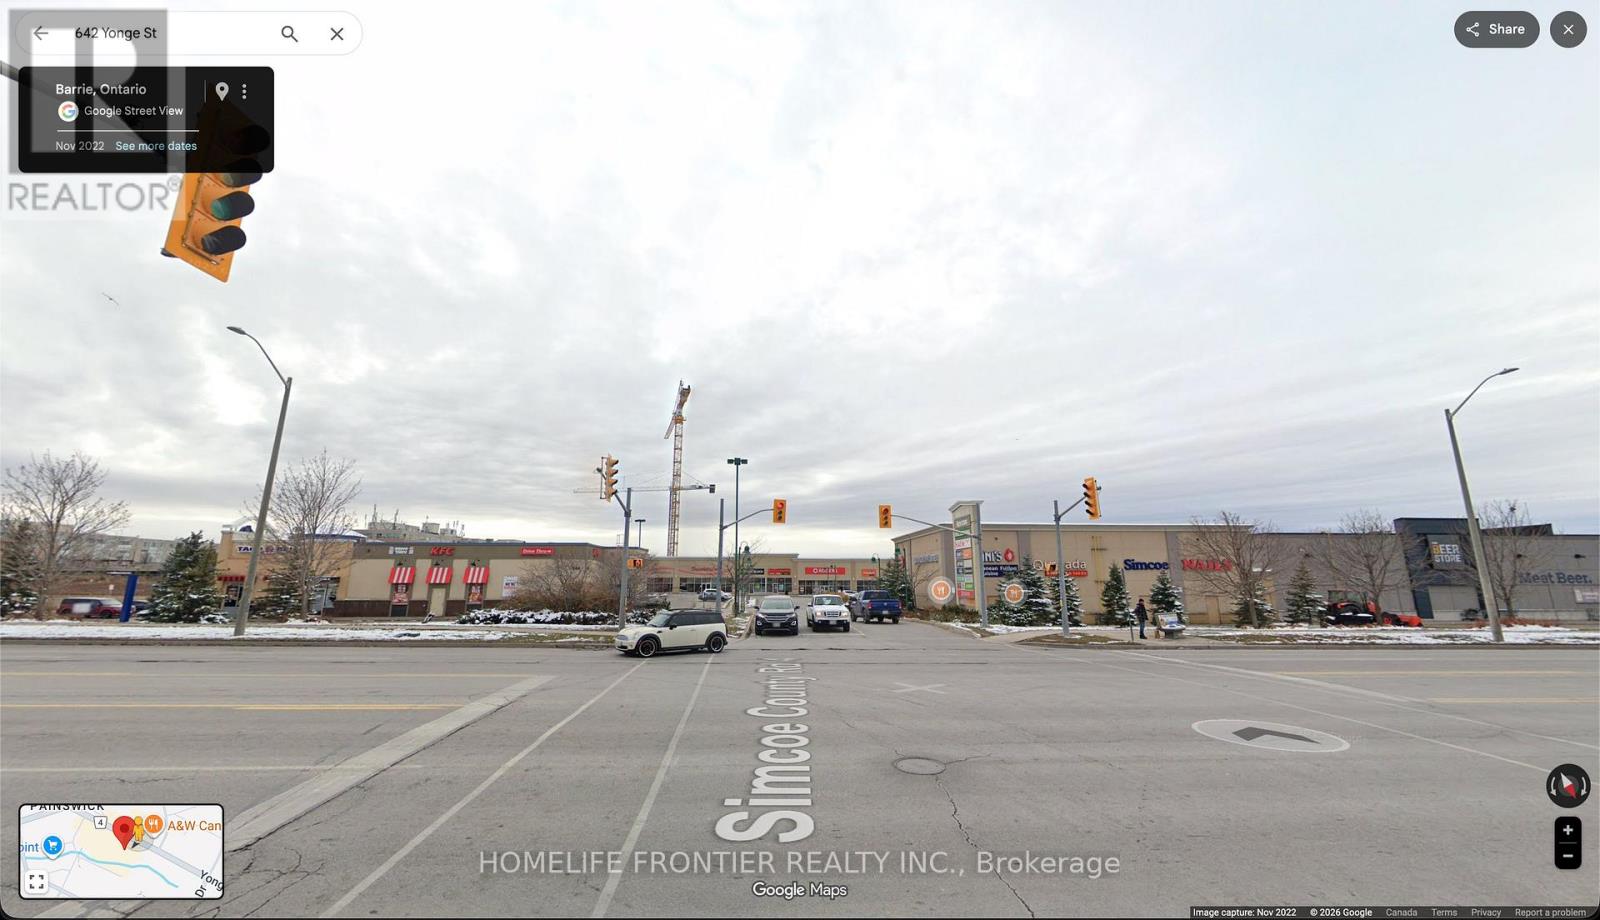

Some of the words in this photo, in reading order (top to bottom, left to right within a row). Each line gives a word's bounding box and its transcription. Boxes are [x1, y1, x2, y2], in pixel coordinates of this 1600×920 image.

[431, 546, 454, 556] KFC
[1431, 544, 1460, 555] BEER
[1123, 559, 1168, 571] Simcoe
[1556, 572, 1592, 584] Beer.
